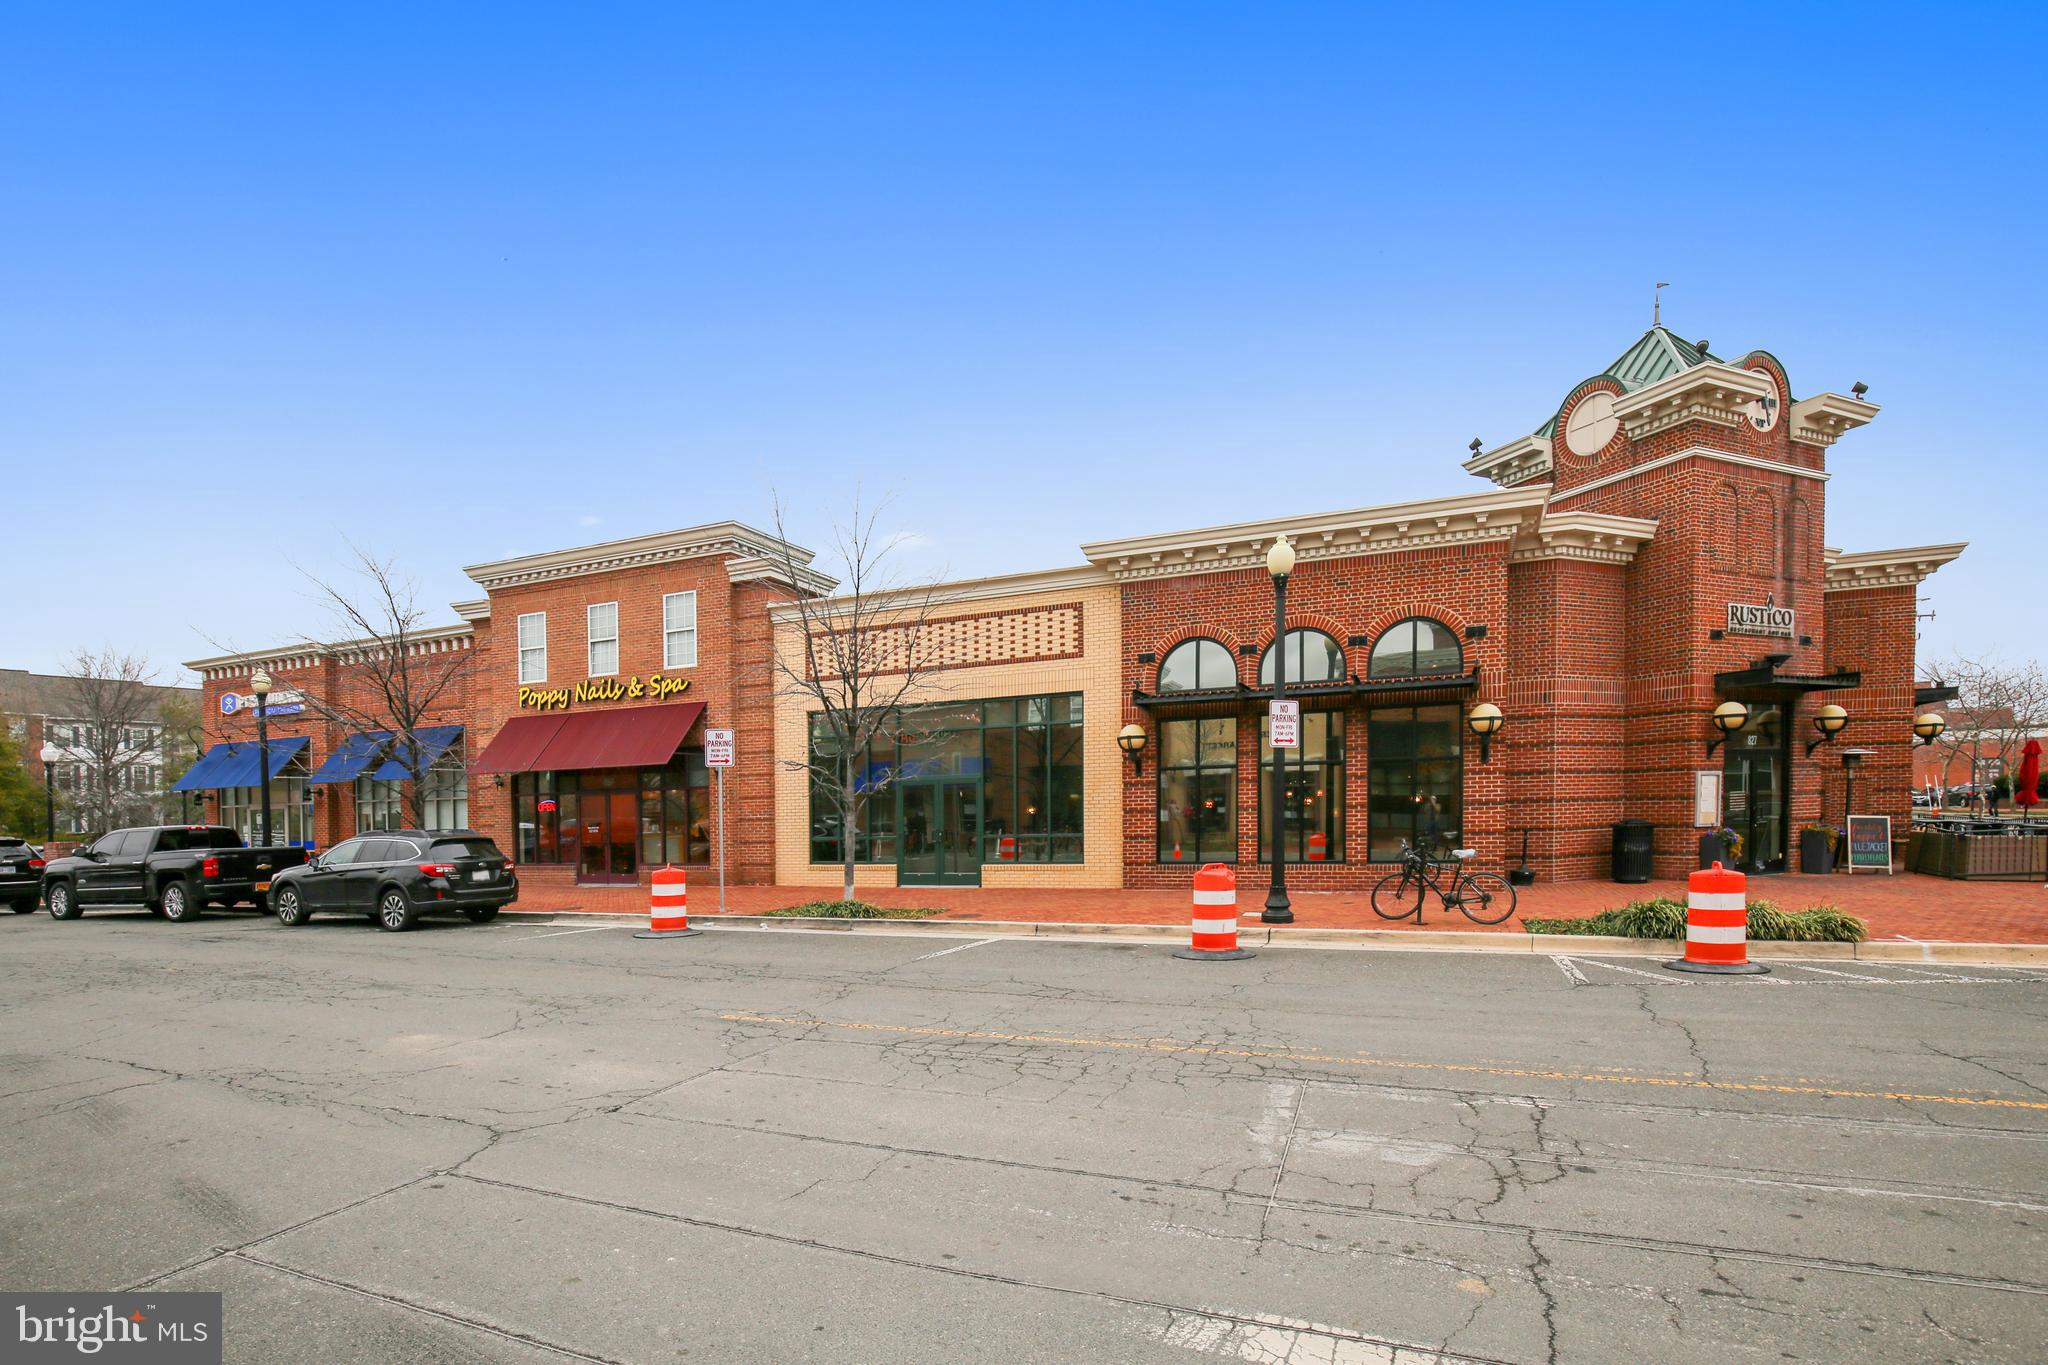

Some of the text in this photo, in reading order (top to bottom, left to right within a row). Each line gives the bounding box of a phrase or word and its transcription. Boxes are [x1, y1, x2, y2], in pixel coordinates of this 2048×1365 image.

[518, 674, 688, 711] Poppy Nails & Spa
[1280, 704, 1289, 713] NO
[1272, 714, 1296, 723] PARKING
[715, 732, 724, 740] NO
[1747, 735, 1758, 746] 827
[707, 740, 732, 748] PARKING
